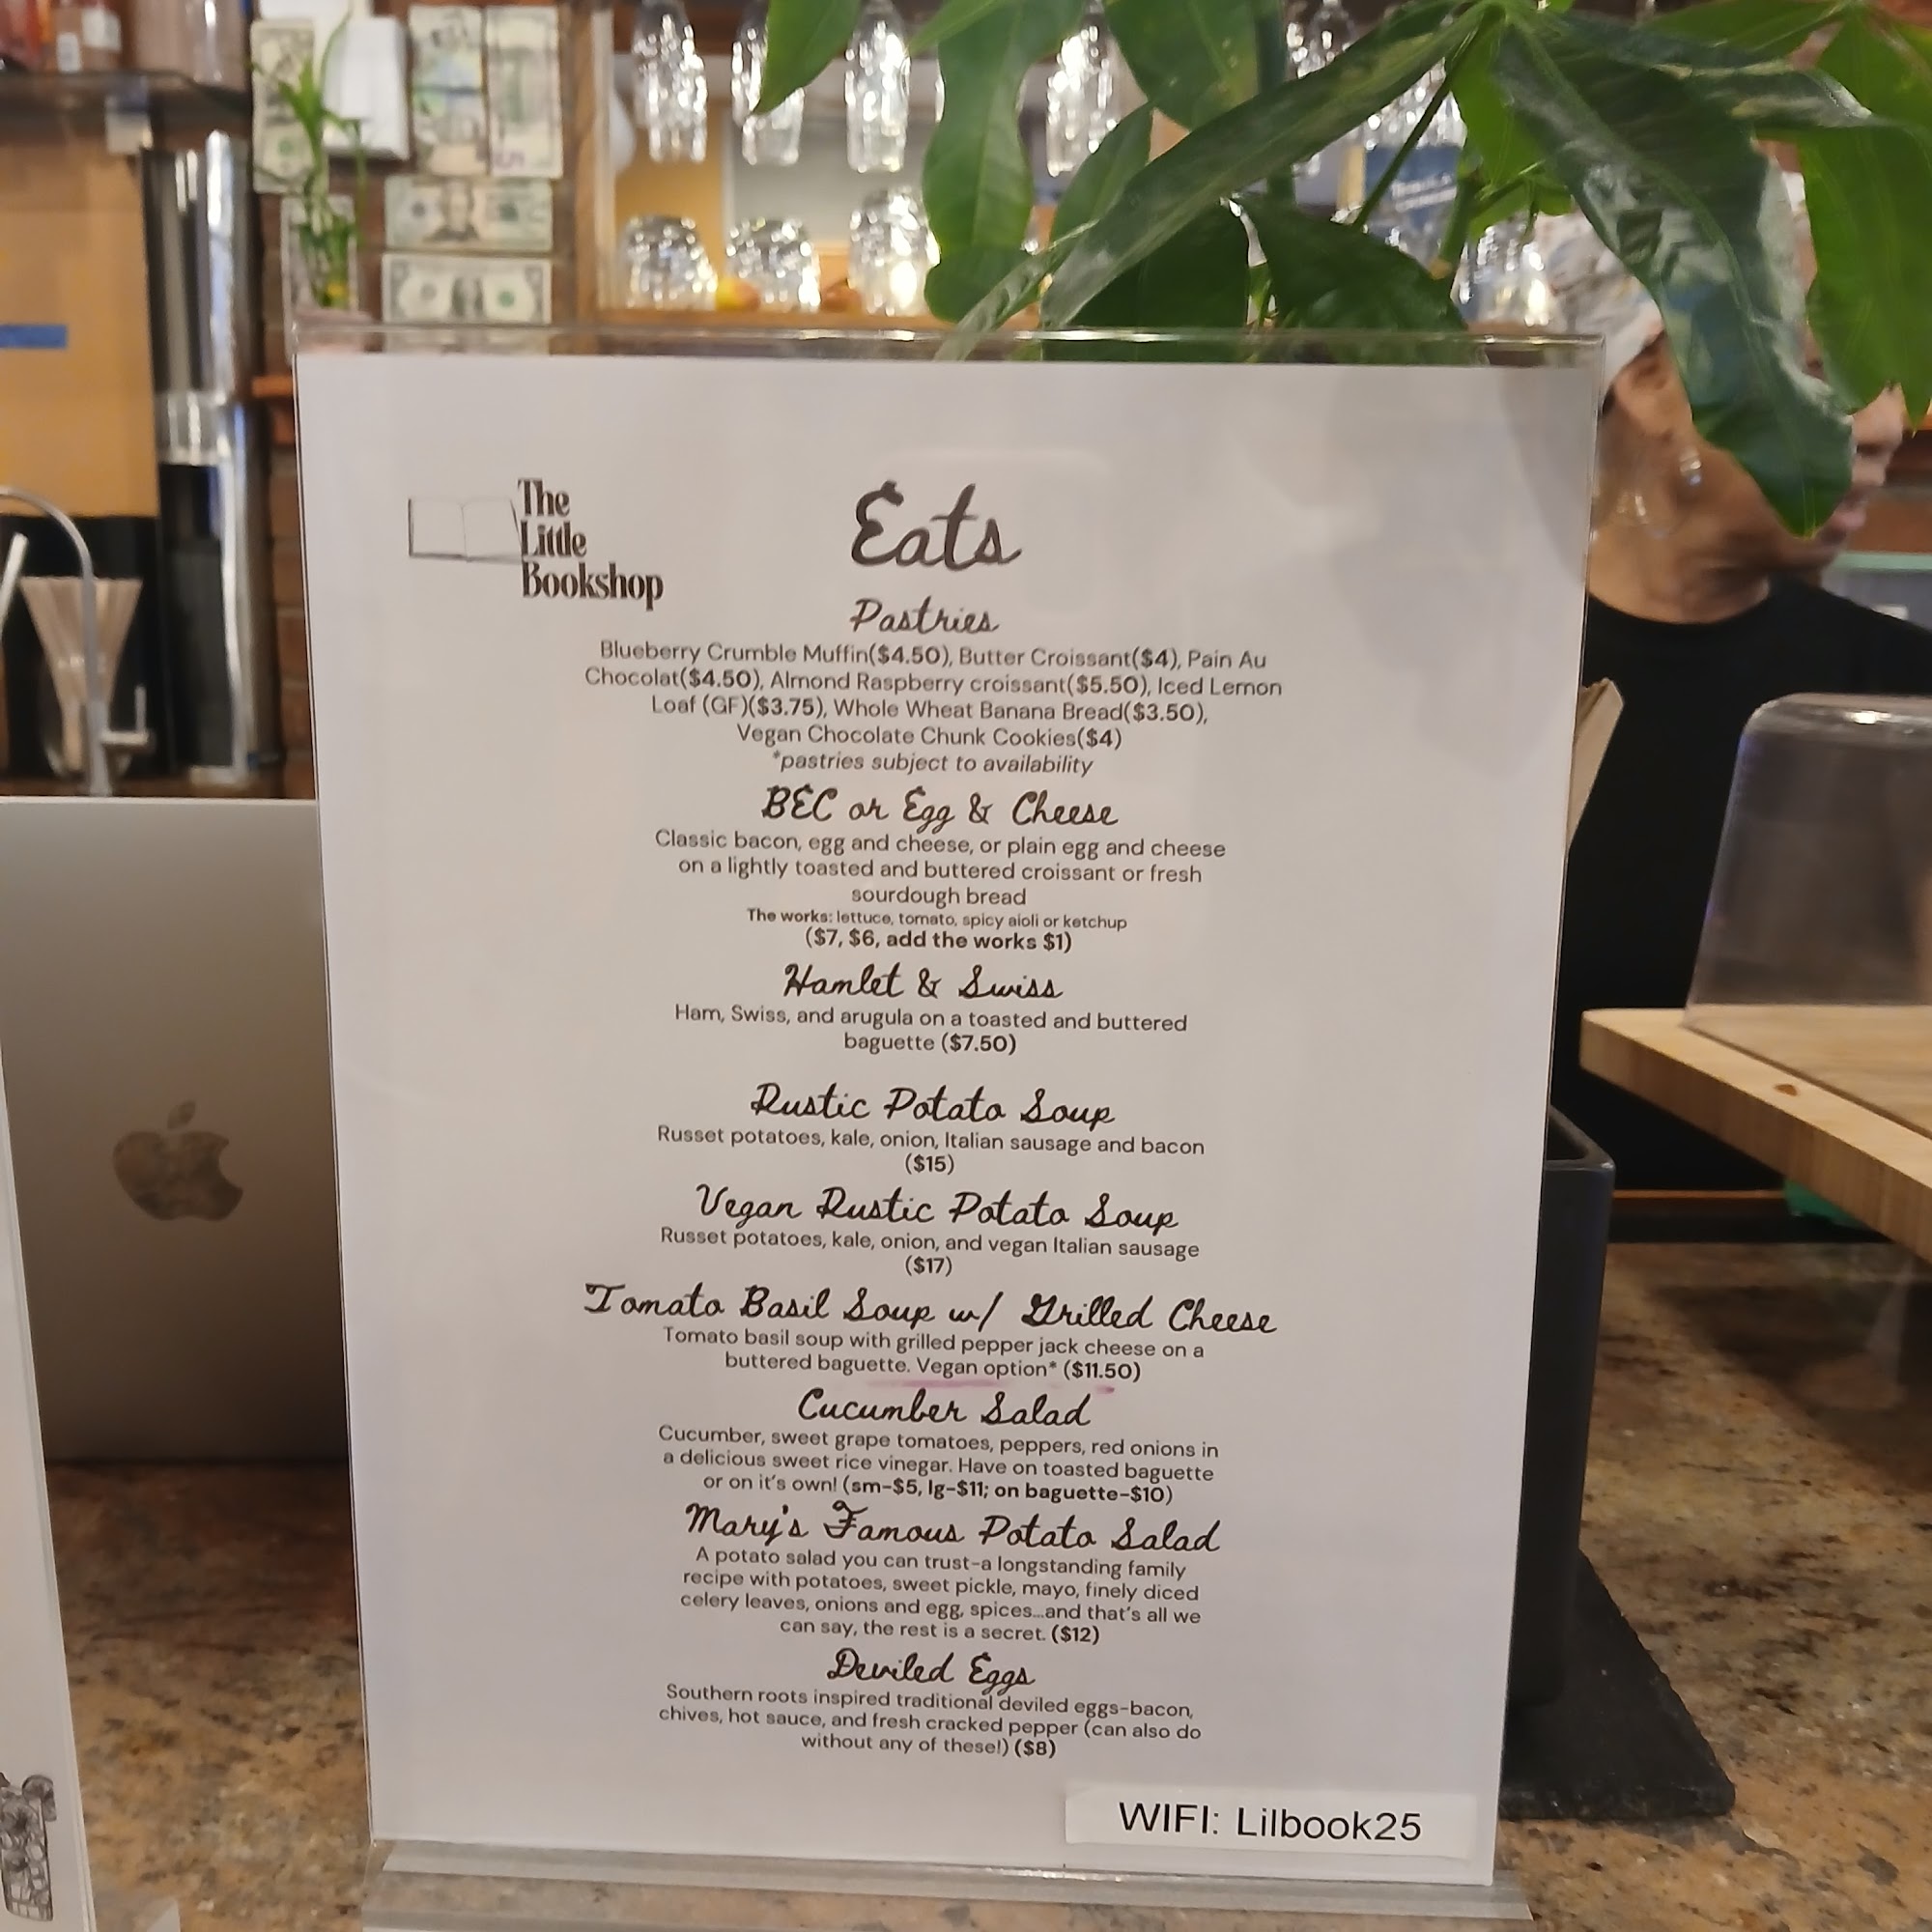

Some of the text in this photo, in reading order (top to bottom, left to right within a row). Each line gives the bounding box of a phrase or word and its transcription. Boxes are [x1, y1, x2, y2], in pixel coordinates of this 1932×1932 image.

[518, 477, 570, 517] The
[521, 519, 587, 557] Little
[850, 478, 1023, 573] Eats
[522, 559, 664, 612] Bookshop
[848, 594, 1000, 636] Pastries
[600, 639, 1266, 672] Blueberry Crumble Muffin($4.50), Butter Croissant($4), Pain Au
[584, 665, 1282, 698] Chocolat($4.50), Almond Raspberry croissant($5.50), Iced Lemon
[651, 694, 696, 714] Loaf
[833, 696, 899, 719] Whole
[905, 698, 974, 719] Wheat
[980, 699, 1056, 721] Banana
[1062, 699, 1208, 725] Bread($3.50),
[735, 722, 1122, 752] Vegan Chocolate Chunk Cookies($4)
[870, 751, 949, 776] subject
[955, 754, 978, 772] to
[982, 753, 1094, 779] availability
[760, 781, 1120, 836] BEC or Egg & Cheese
[654, 827, 1226, 861] Classic bacon, egg and cheese, or plain egg and cheese
[851, 885, 1027, 910] sourdough bread
[746, 906, 1127, 932] The works: lettuce, tomato, spicy aioli or ketchup
[805, 924, 1072, 954] ($7, $6, add the works $1)
[782, 961, 1065, 1000] Hamlet & Swiss
[674, 1002, 1187, 1033] Ham, Swiss, and arugula on a toasted and buttered
[843, 1030, 1016, 1057] baguette ($7.50)
[750, 1081, 1116, 1133] Rustic Potato Soup
[657, 1123, 1205, 1157] Russet potatoes, kale, onion, Italian sausage and bacon
[904, 1151, 955, 1176] ($15)
[695, 1182, 1179, 1237] Vegan Rustic Potato Soup
[904, 1254, 952, 1278] ($17)
[582, 1280, 1278, 1334] Tomato Basil Soup w/ Grilled Cheese
[724, 1350, 812, 1371] buttered
[817, 1352, 911, 1377] baguette.
[916, 1355, 978, 1379] Vegan
[1063, 1358, 1141, 1383] ($11.50)
[798, 1387, 1091, 1426] Cucumber Salad
[658, 1423, 1219, 1459] Cucumber, sweet grape tomatoes, peppers, red onions in
[684, 1498, 1221, 1552] Mary's Famous Potato Salad
[683, 1568, 1199, 1604] recipe with potatoes, sweet pickle, mayo, finely diced
[780, 1618, 1100, 1646] can say, the rest is a secret. ($12)
[827, 1647, 1036, 1696] Deviled Eggs
[666, 1683, 753, 1702] Southern
[757, 1690, 809, 1704] roots
[813, 1689, 891, 1709] inspired
[896, 1692, 993, 1711] traditional
[998, 1695, 1068, 1714] deviled
[801, 1733, 1057, 1759] without any of these!) ($8)
[1119, 1801, 1422, 1841] WIFI: Lilbook25
